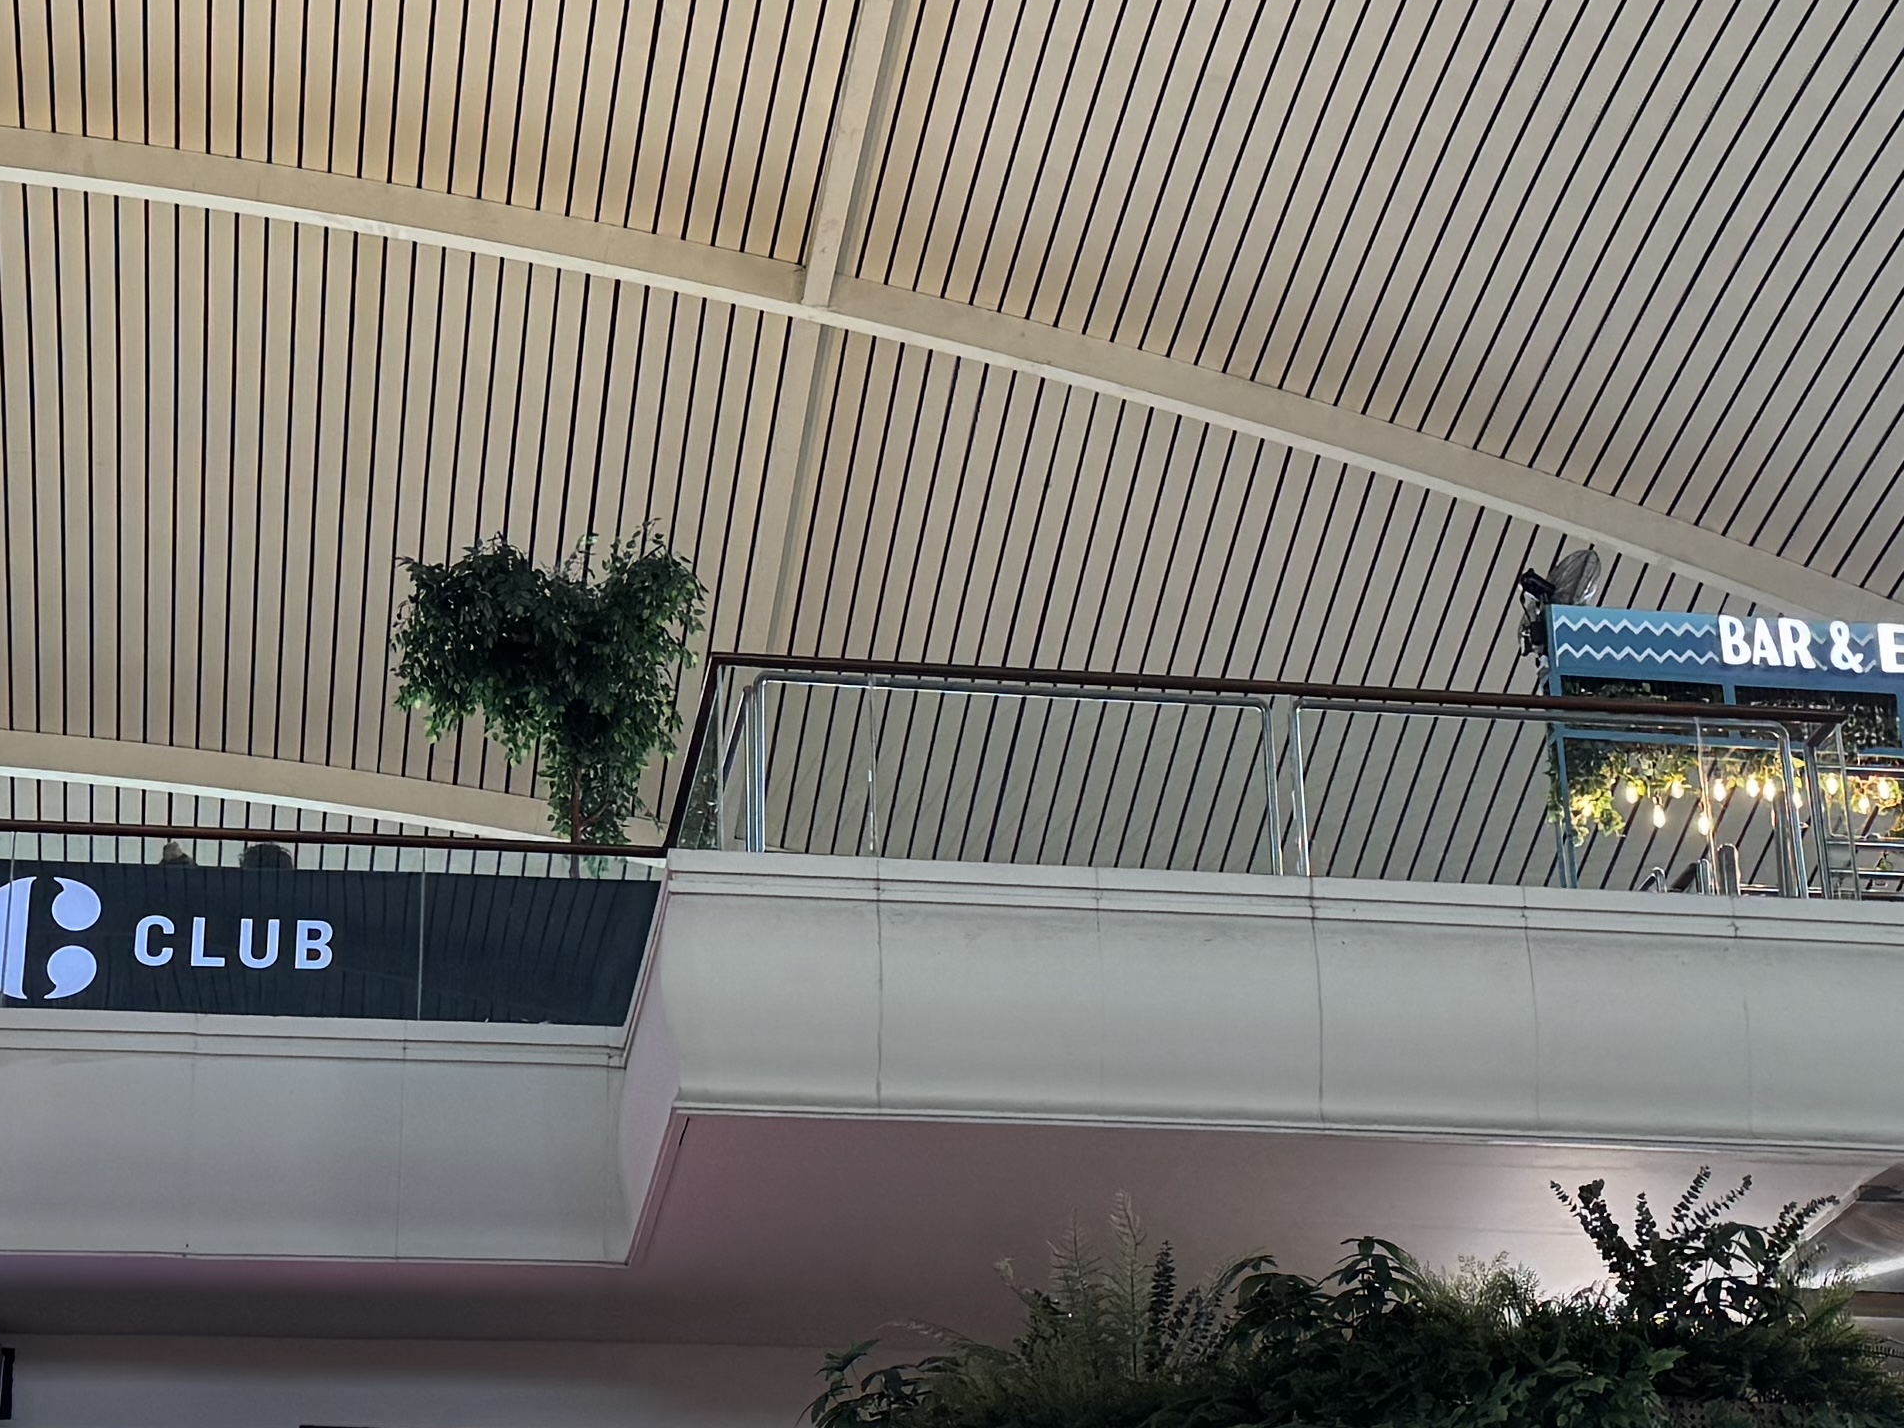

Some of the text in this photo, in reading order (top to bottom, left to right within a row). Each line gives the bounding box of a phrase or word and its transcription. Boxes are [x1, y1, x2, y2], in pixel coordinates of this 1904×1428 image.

[1718, 613, 1816, 672] BAR
[1828, 623, 1865, 674] &
[132, 913, 334, 971] CLUB
